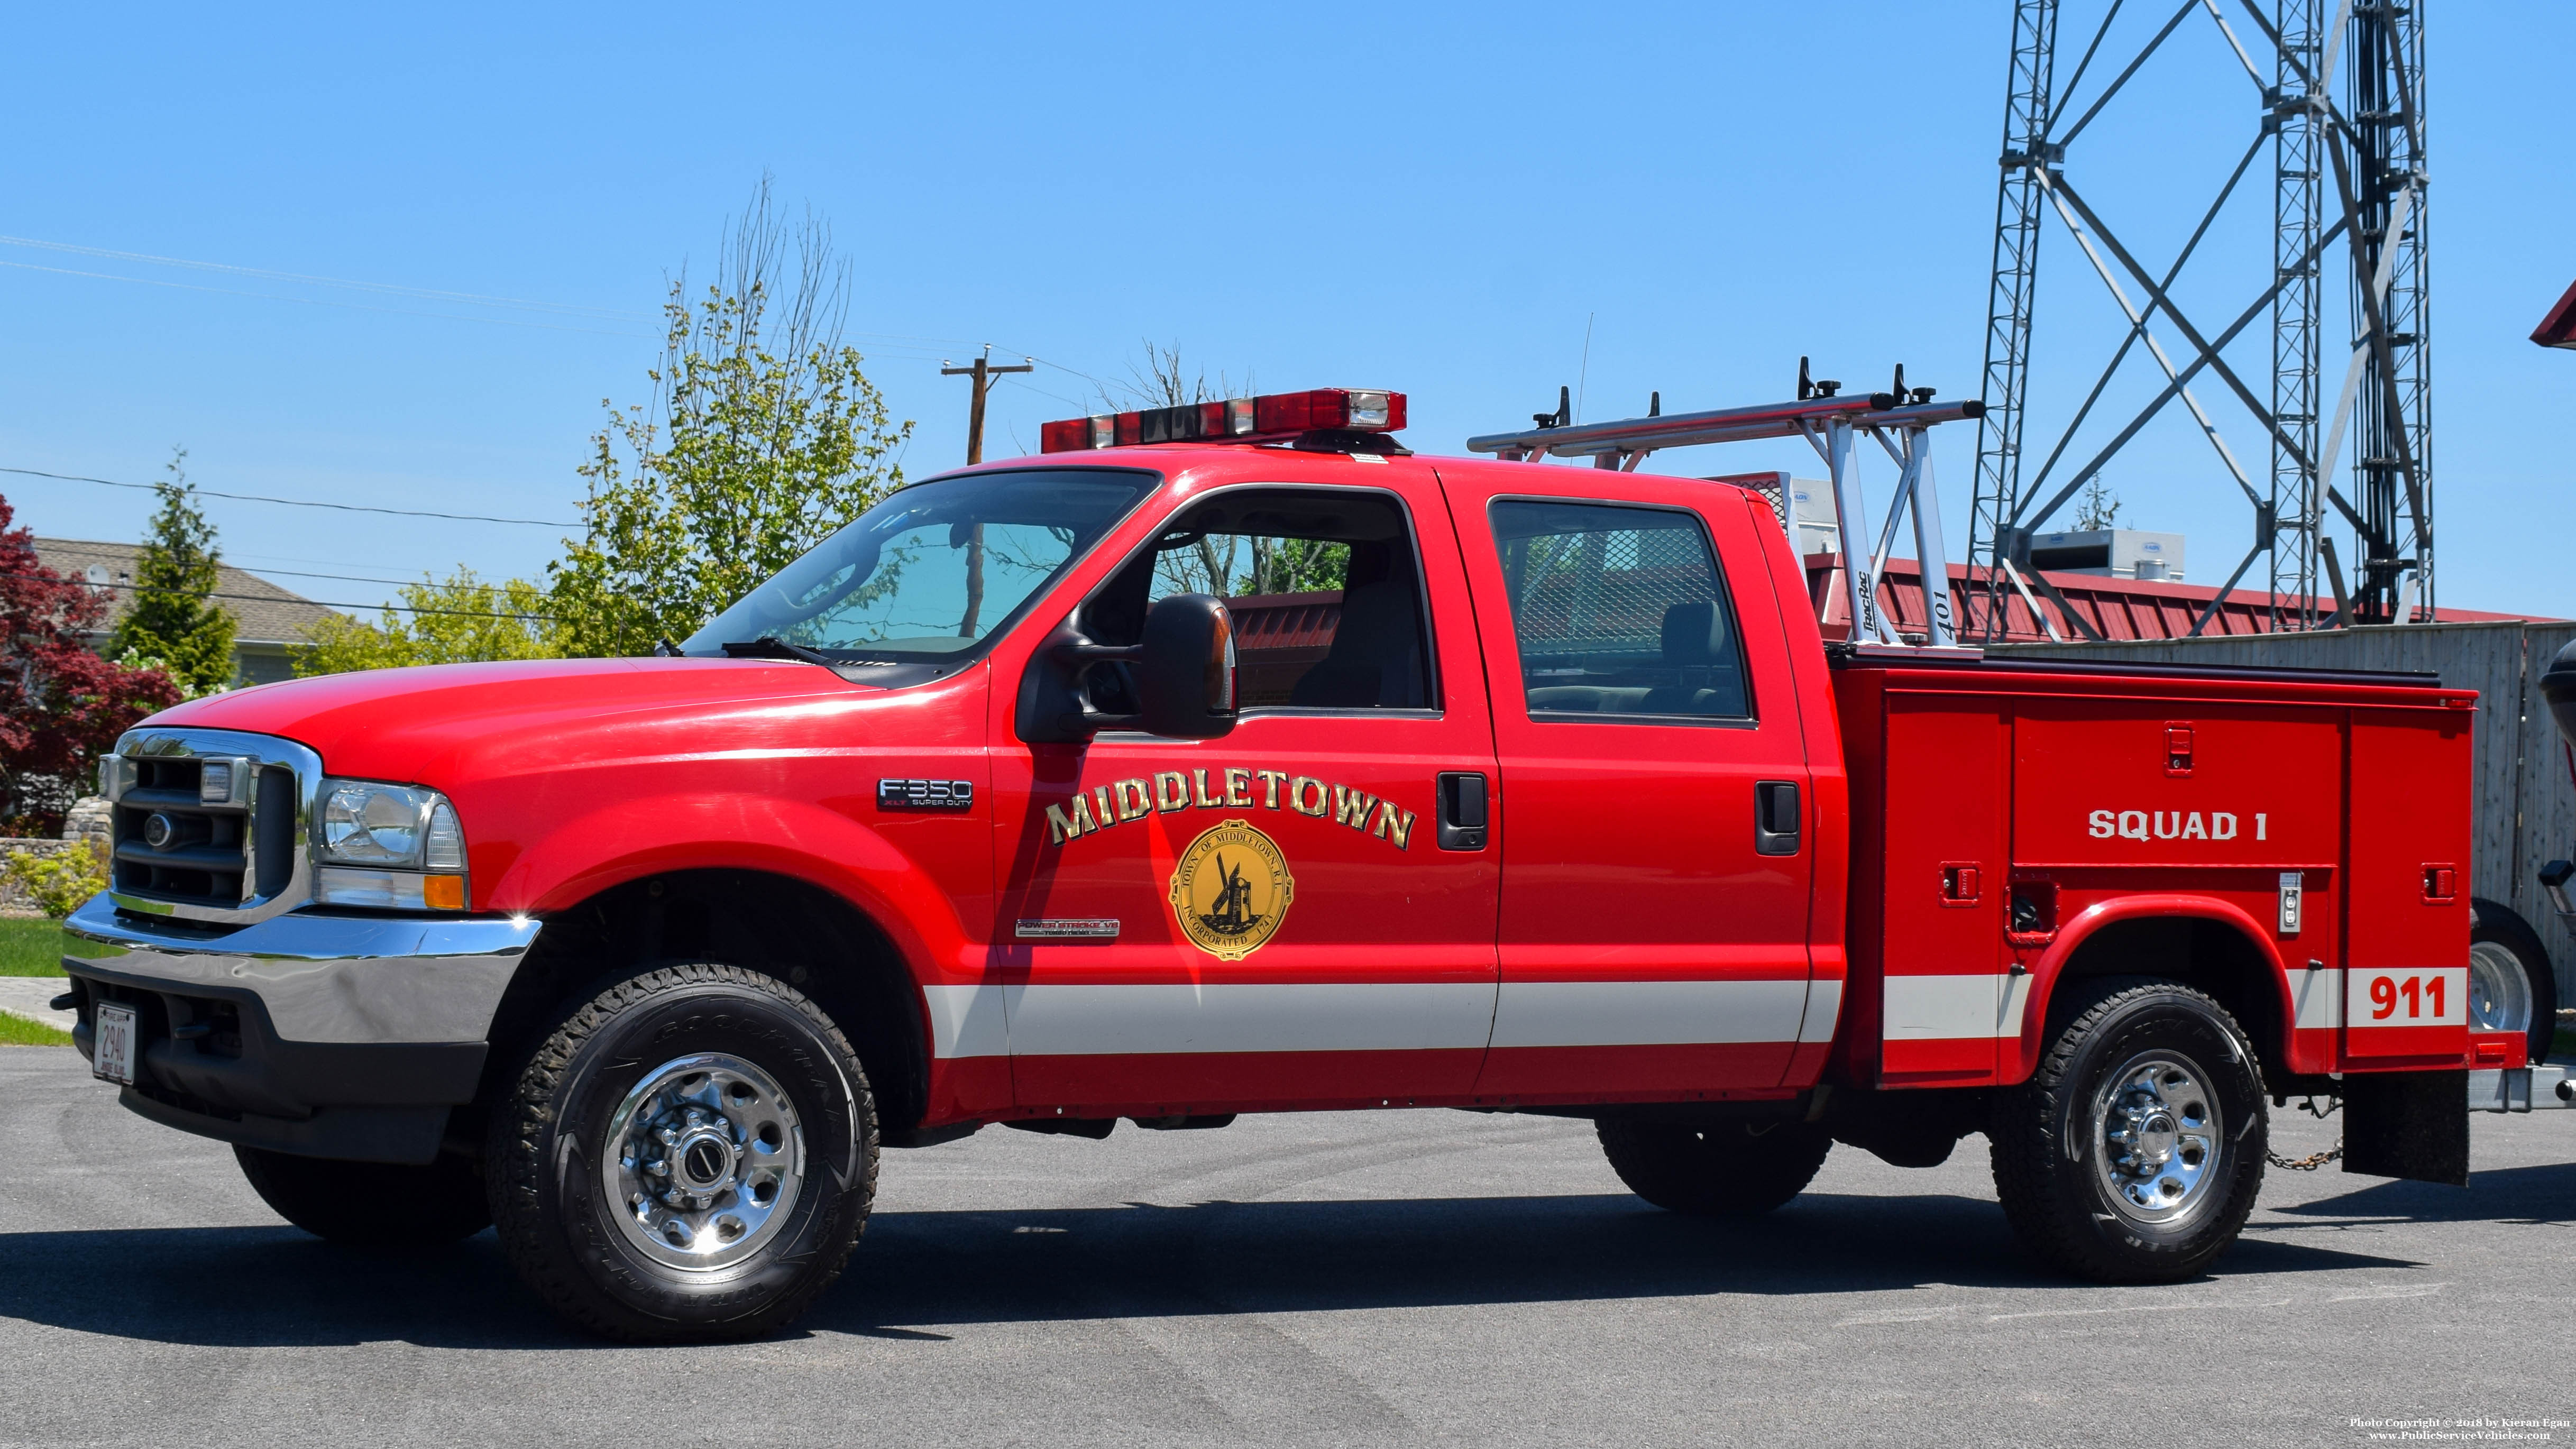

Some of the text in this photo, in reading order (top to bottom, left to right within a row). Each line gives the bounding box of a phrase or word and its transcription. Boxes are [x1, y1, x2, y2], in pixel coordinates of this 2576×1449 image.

[1933, 592, 1955, 640] 401
[1045, 767, 1417, 851] MIDDLETOWN
[2089, 810, 2267, 842] SQUAD 1
[1183, 855, 1199, 887] TOWN
[1201, 839, 1212, 852] OF
[1184, 905, 1273, 947] INCORPORATED 1743
[2370, 976, 2445, 1020] 911
[103, 1025, 125, 1062] 2940
